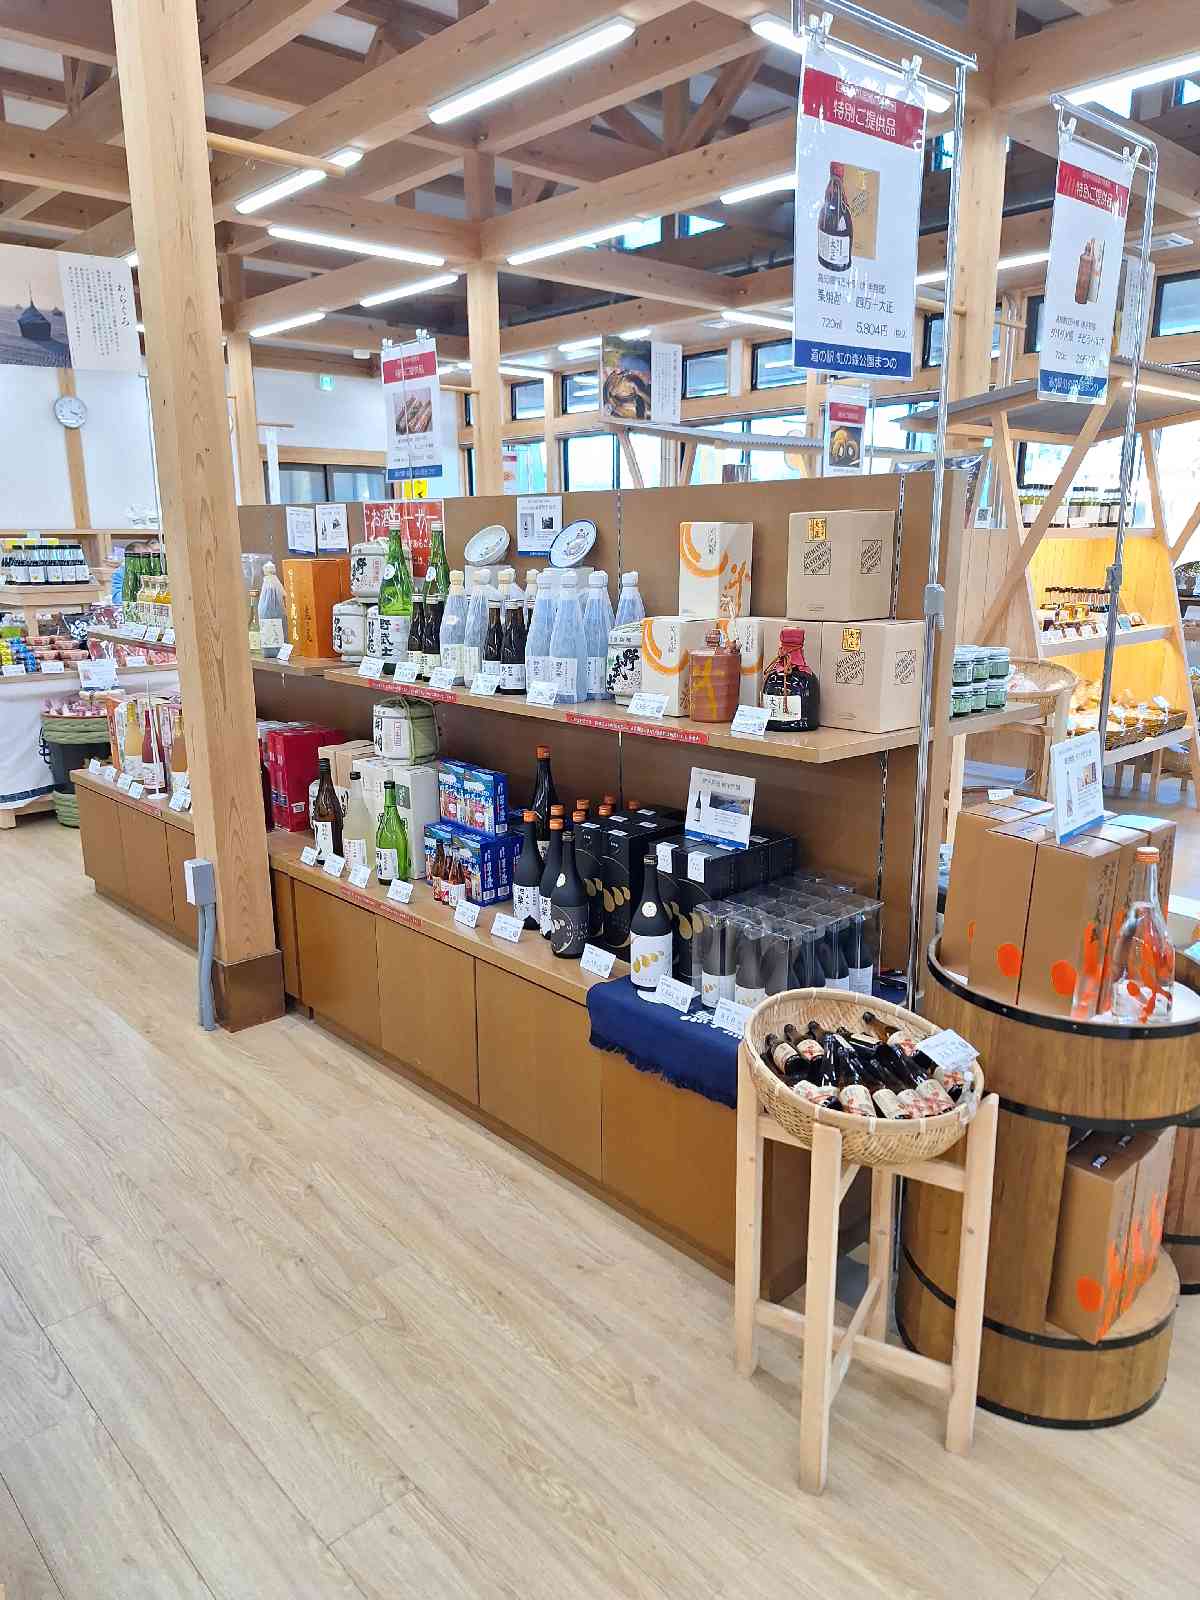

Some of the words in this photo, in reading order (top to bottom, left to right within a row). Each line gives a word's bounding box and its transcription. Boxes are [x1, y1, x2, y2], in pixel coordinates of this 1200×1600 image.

[833, 99, 897, 137] 特別ご提供品
[768, 697, 777, 718] 大正
